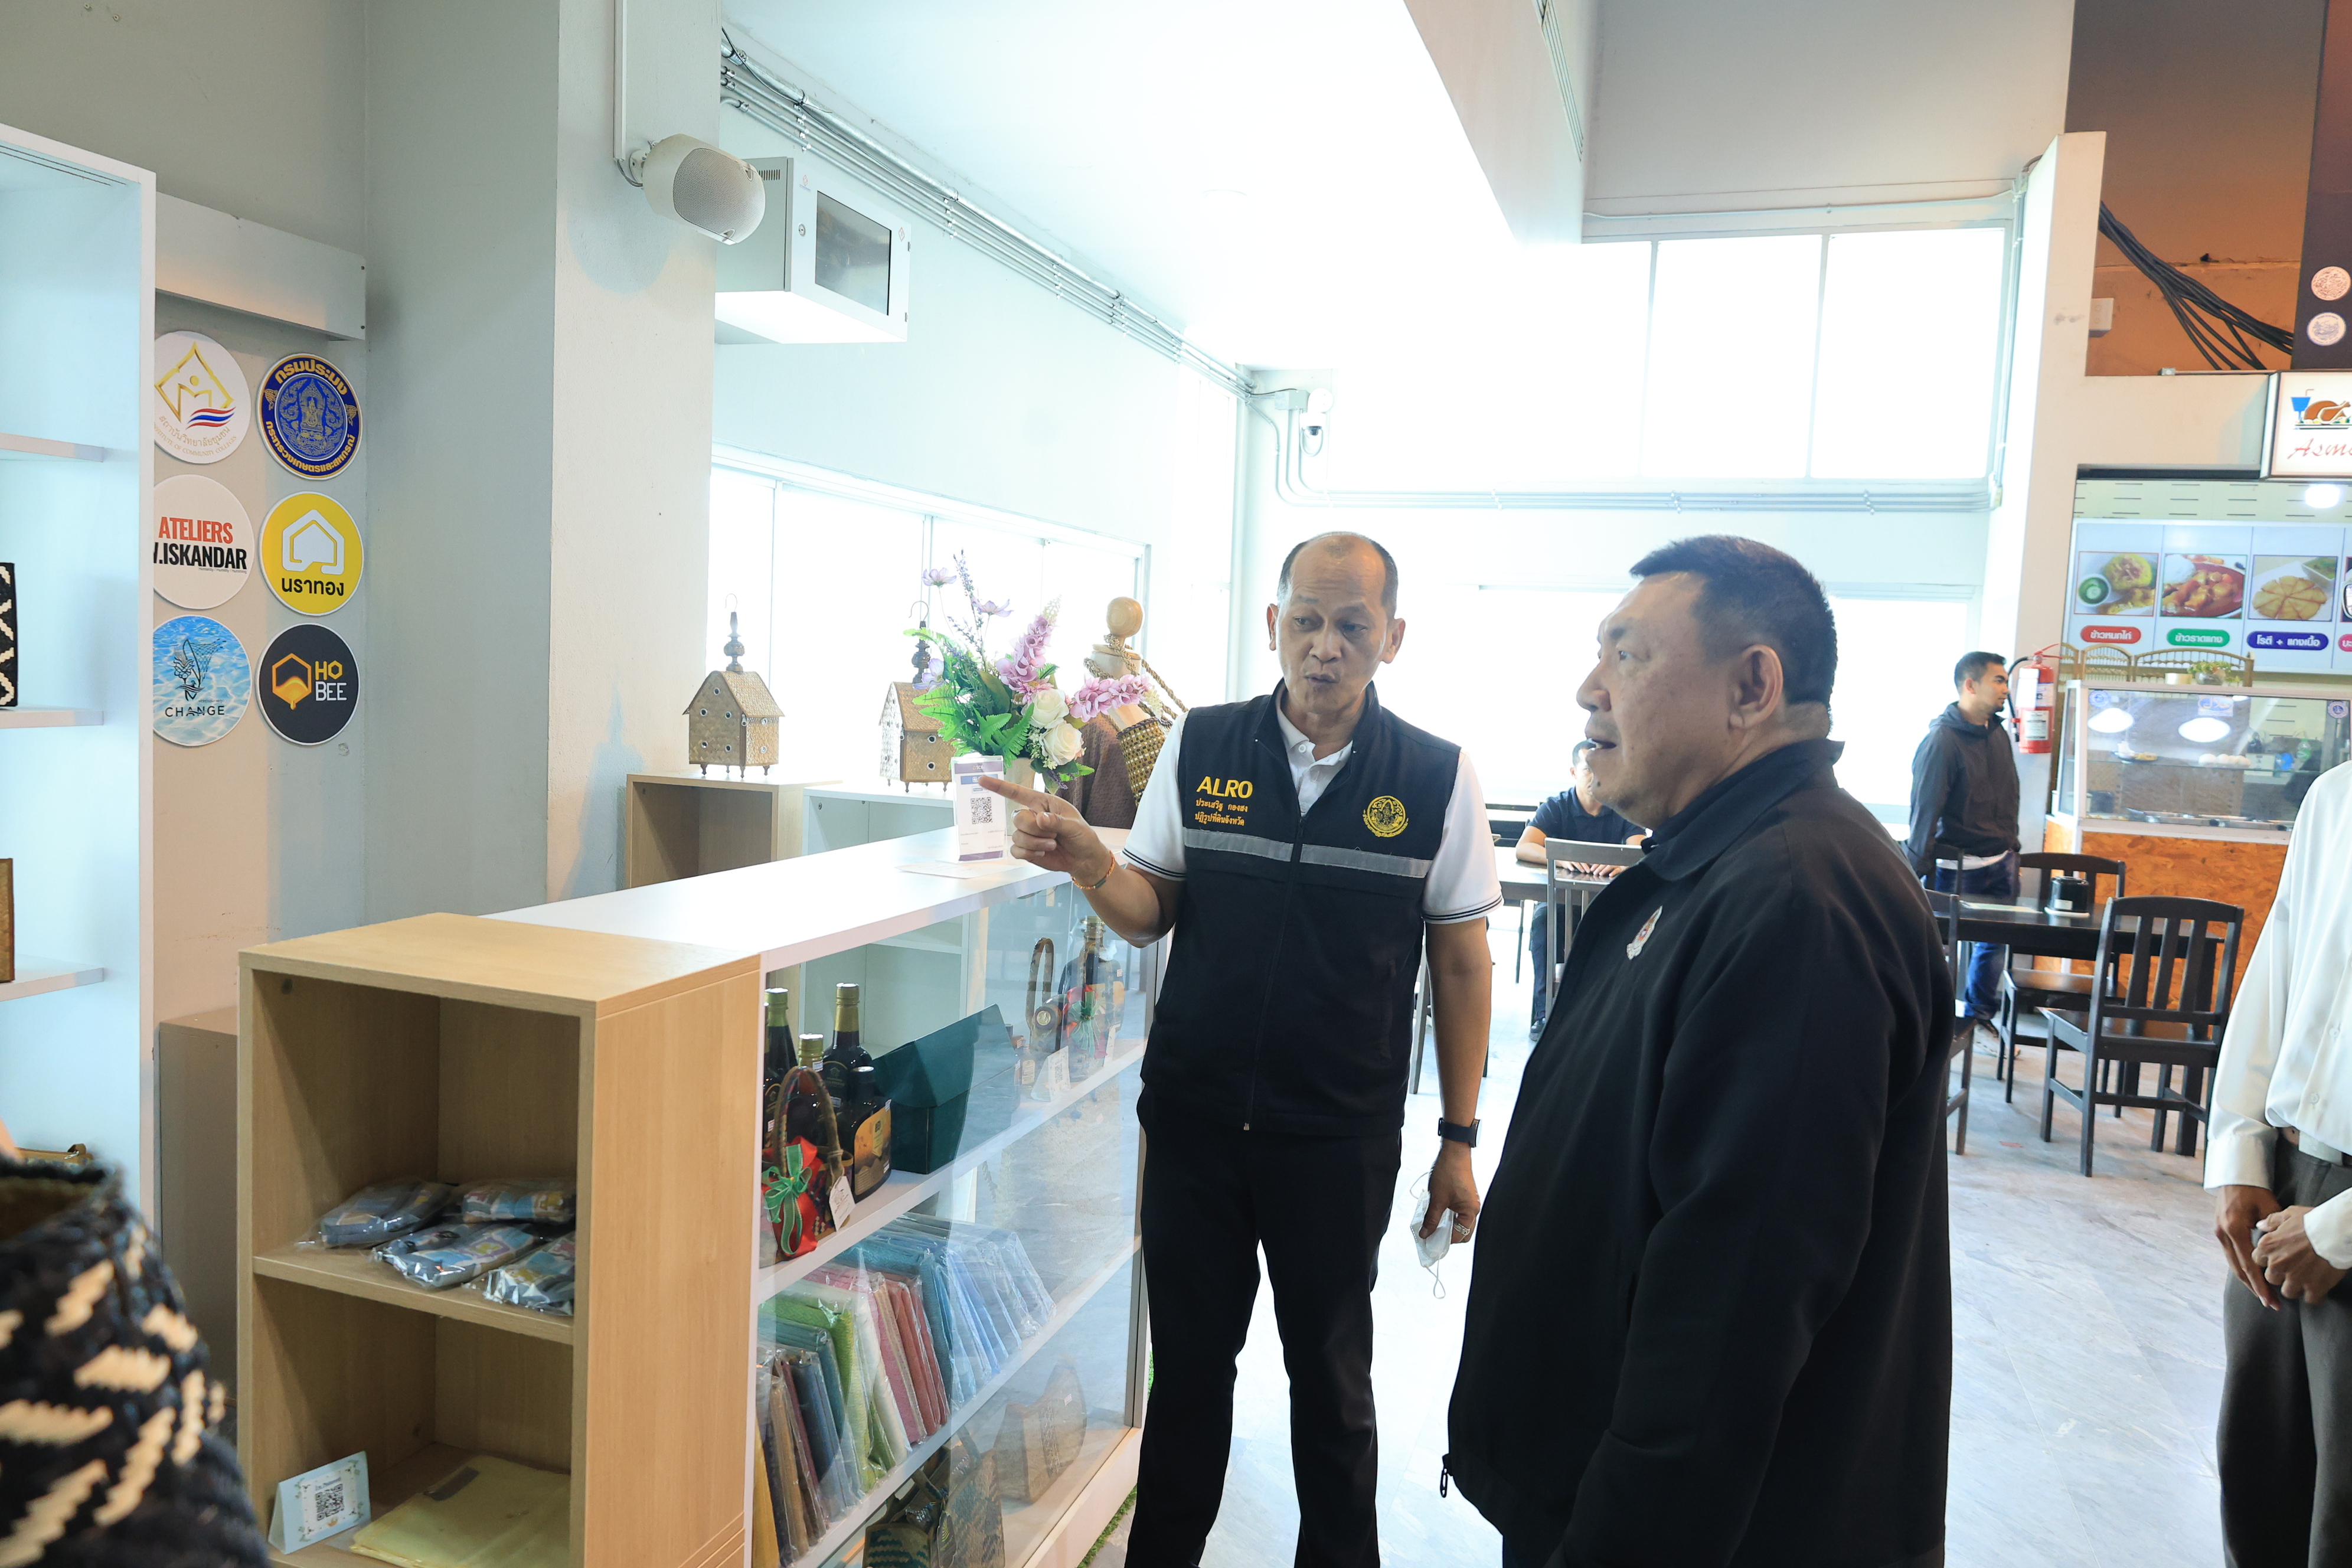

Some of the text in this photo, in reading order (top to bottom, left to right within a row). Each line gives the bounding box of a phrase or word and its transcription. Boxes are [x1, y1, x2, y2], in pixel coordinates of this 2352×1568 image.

[275, 359, 348, 395] กรมประมง
[158, 516, 234, 544] ATELIERS
[282, 577, 344, 596] นราทอง
[2090, 629, 2132, 640] ข้าวหมกไก่
[2175, 632, 2223, 643] ข้าวราดแกง
[2286, 635, 2321, 647] แกงเนื้อ
[315, 660, 343, 681] HO
[315, 681, 347, 701] BEE
[165, 705, 225, 717] CHANGE
[1196, 776, 1253, 799] ALRO
[1195, 798, 1224, 812] ประเสริฐ
